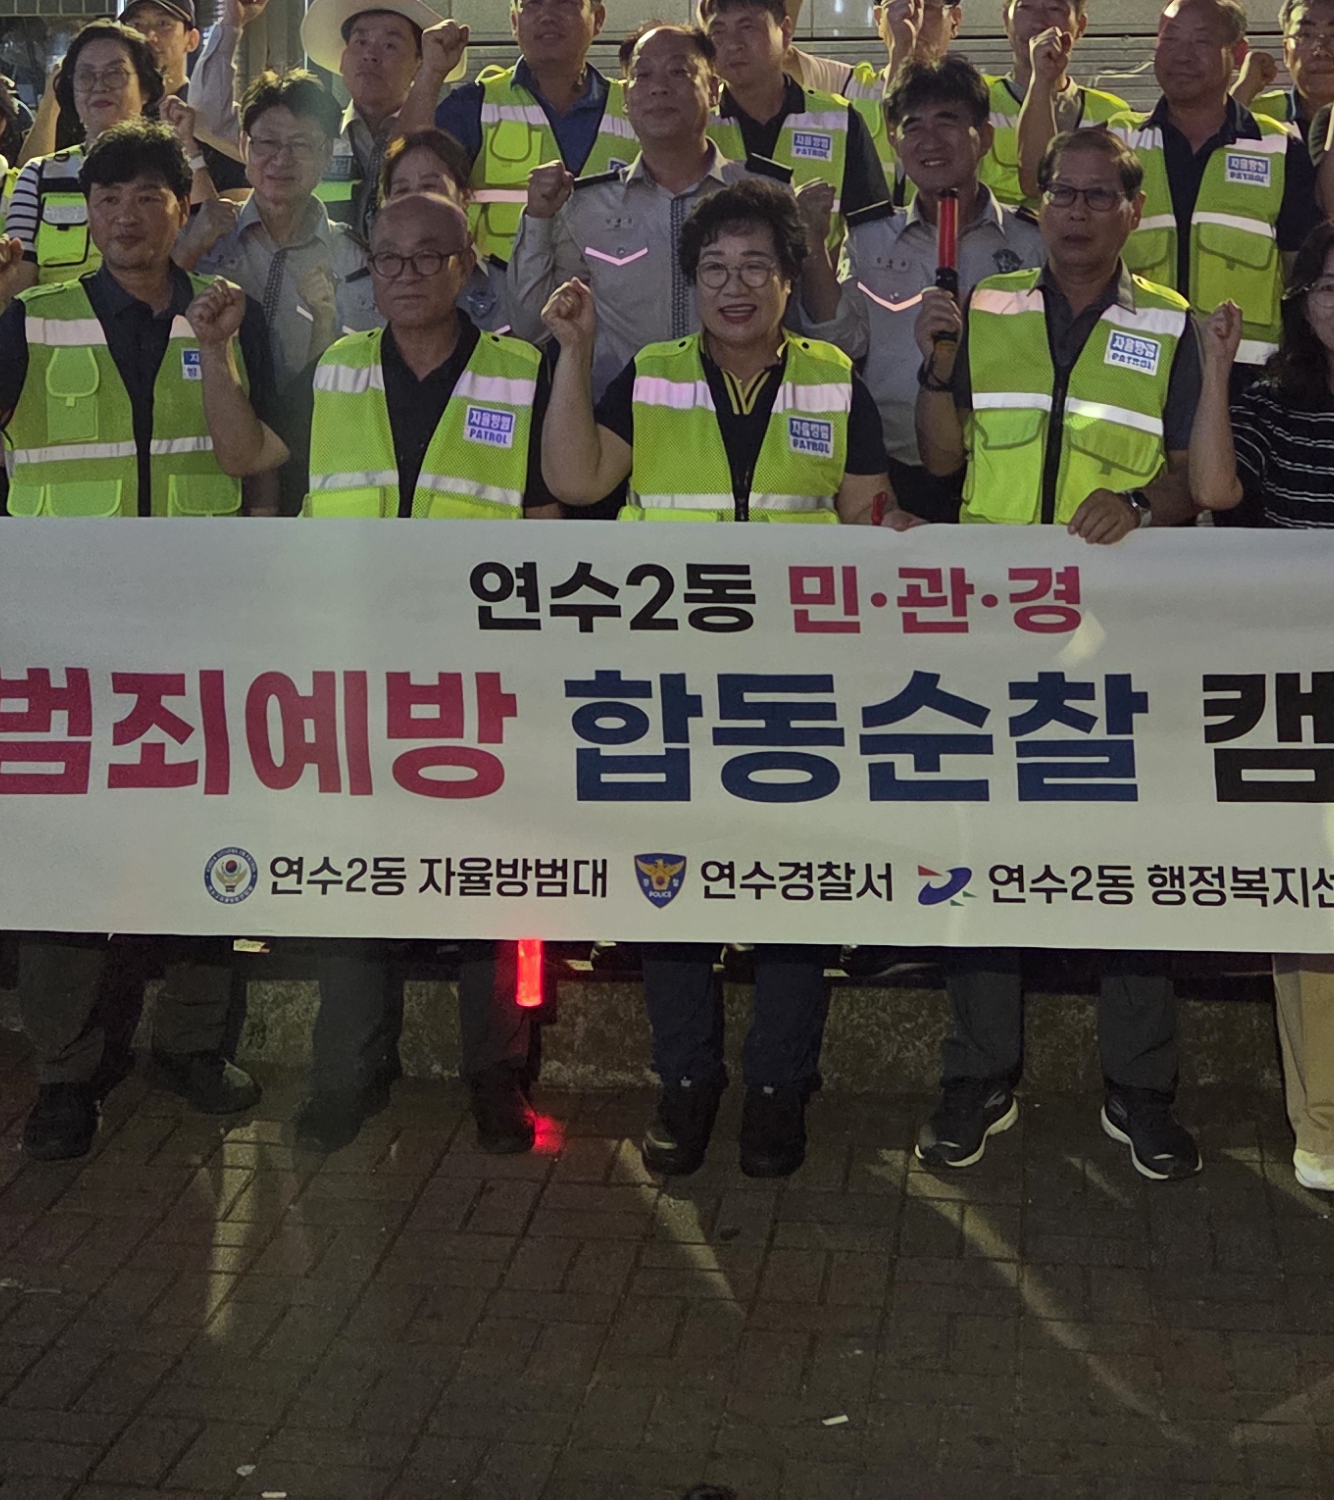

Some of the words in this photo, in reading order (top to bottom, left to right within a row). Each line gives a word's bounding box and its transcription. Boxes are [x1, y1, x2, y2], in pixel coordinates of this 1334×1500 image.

[794, 146, 829, 160] PATROL
[1228, 170, 1267, 183] PATROL
[1111, 353, 1155, 371] PATROL
[471, 409, 514, 431] 자율방범
[469, 428, 509, 444] PATROL
[792, 439, 830, 455] PATROL
[469, 560, 758, 634] 연수2동
[787, 564, 1084, 635] 민·관·경
[564, 668, 1150, 803] 합동순찰
[268, 855, 407, 898] 연수2동
[419, 856, 608, 899] 자율방범대
[699, 860, 895, 903] 연수경찰서
[988, 862, 1136, 906] 연수2동
[648, 890, 672, 898] POLICE
